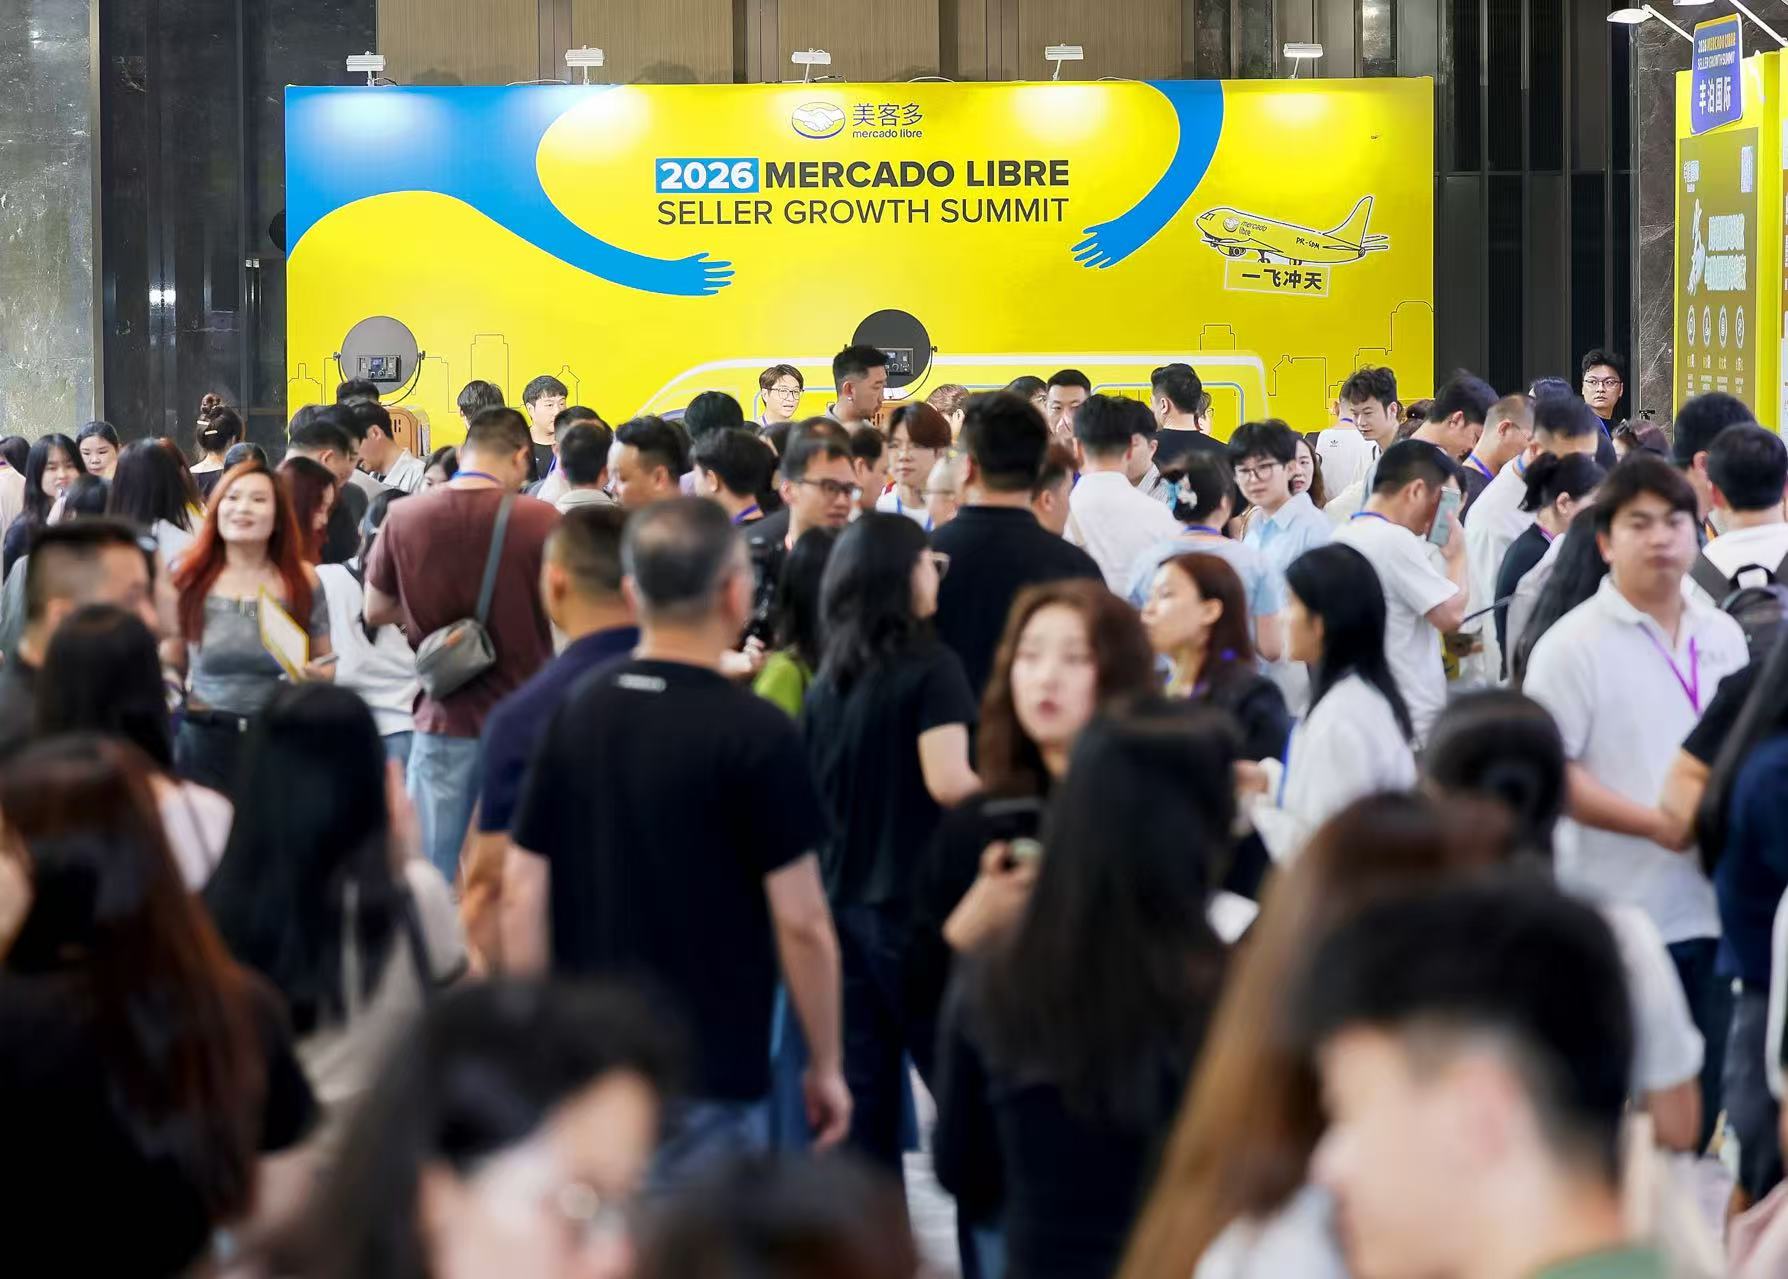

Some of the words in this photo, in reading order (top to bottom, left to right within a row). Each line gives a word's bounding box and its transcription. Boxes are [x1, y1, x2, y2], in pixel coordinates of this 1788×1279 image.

[852, 102, 923, 127] 美客多
[852, 128, 898, 139] mercado
[899, 128, 923, 138] libre
[660, 161, 754, 190] 2026
[766, 160, 955, 188] MERCADO
[967, 160, 1069, 187] LIBRE
[657, 200, 773, 225] SELLER
[784, 199, 929, 225] GROWTH
[941, 198, 1069, 224] SUMMIT
[1241, 221, 1267, 232] mercado
[1241, 268, 1322, 290] 一飞冲天
